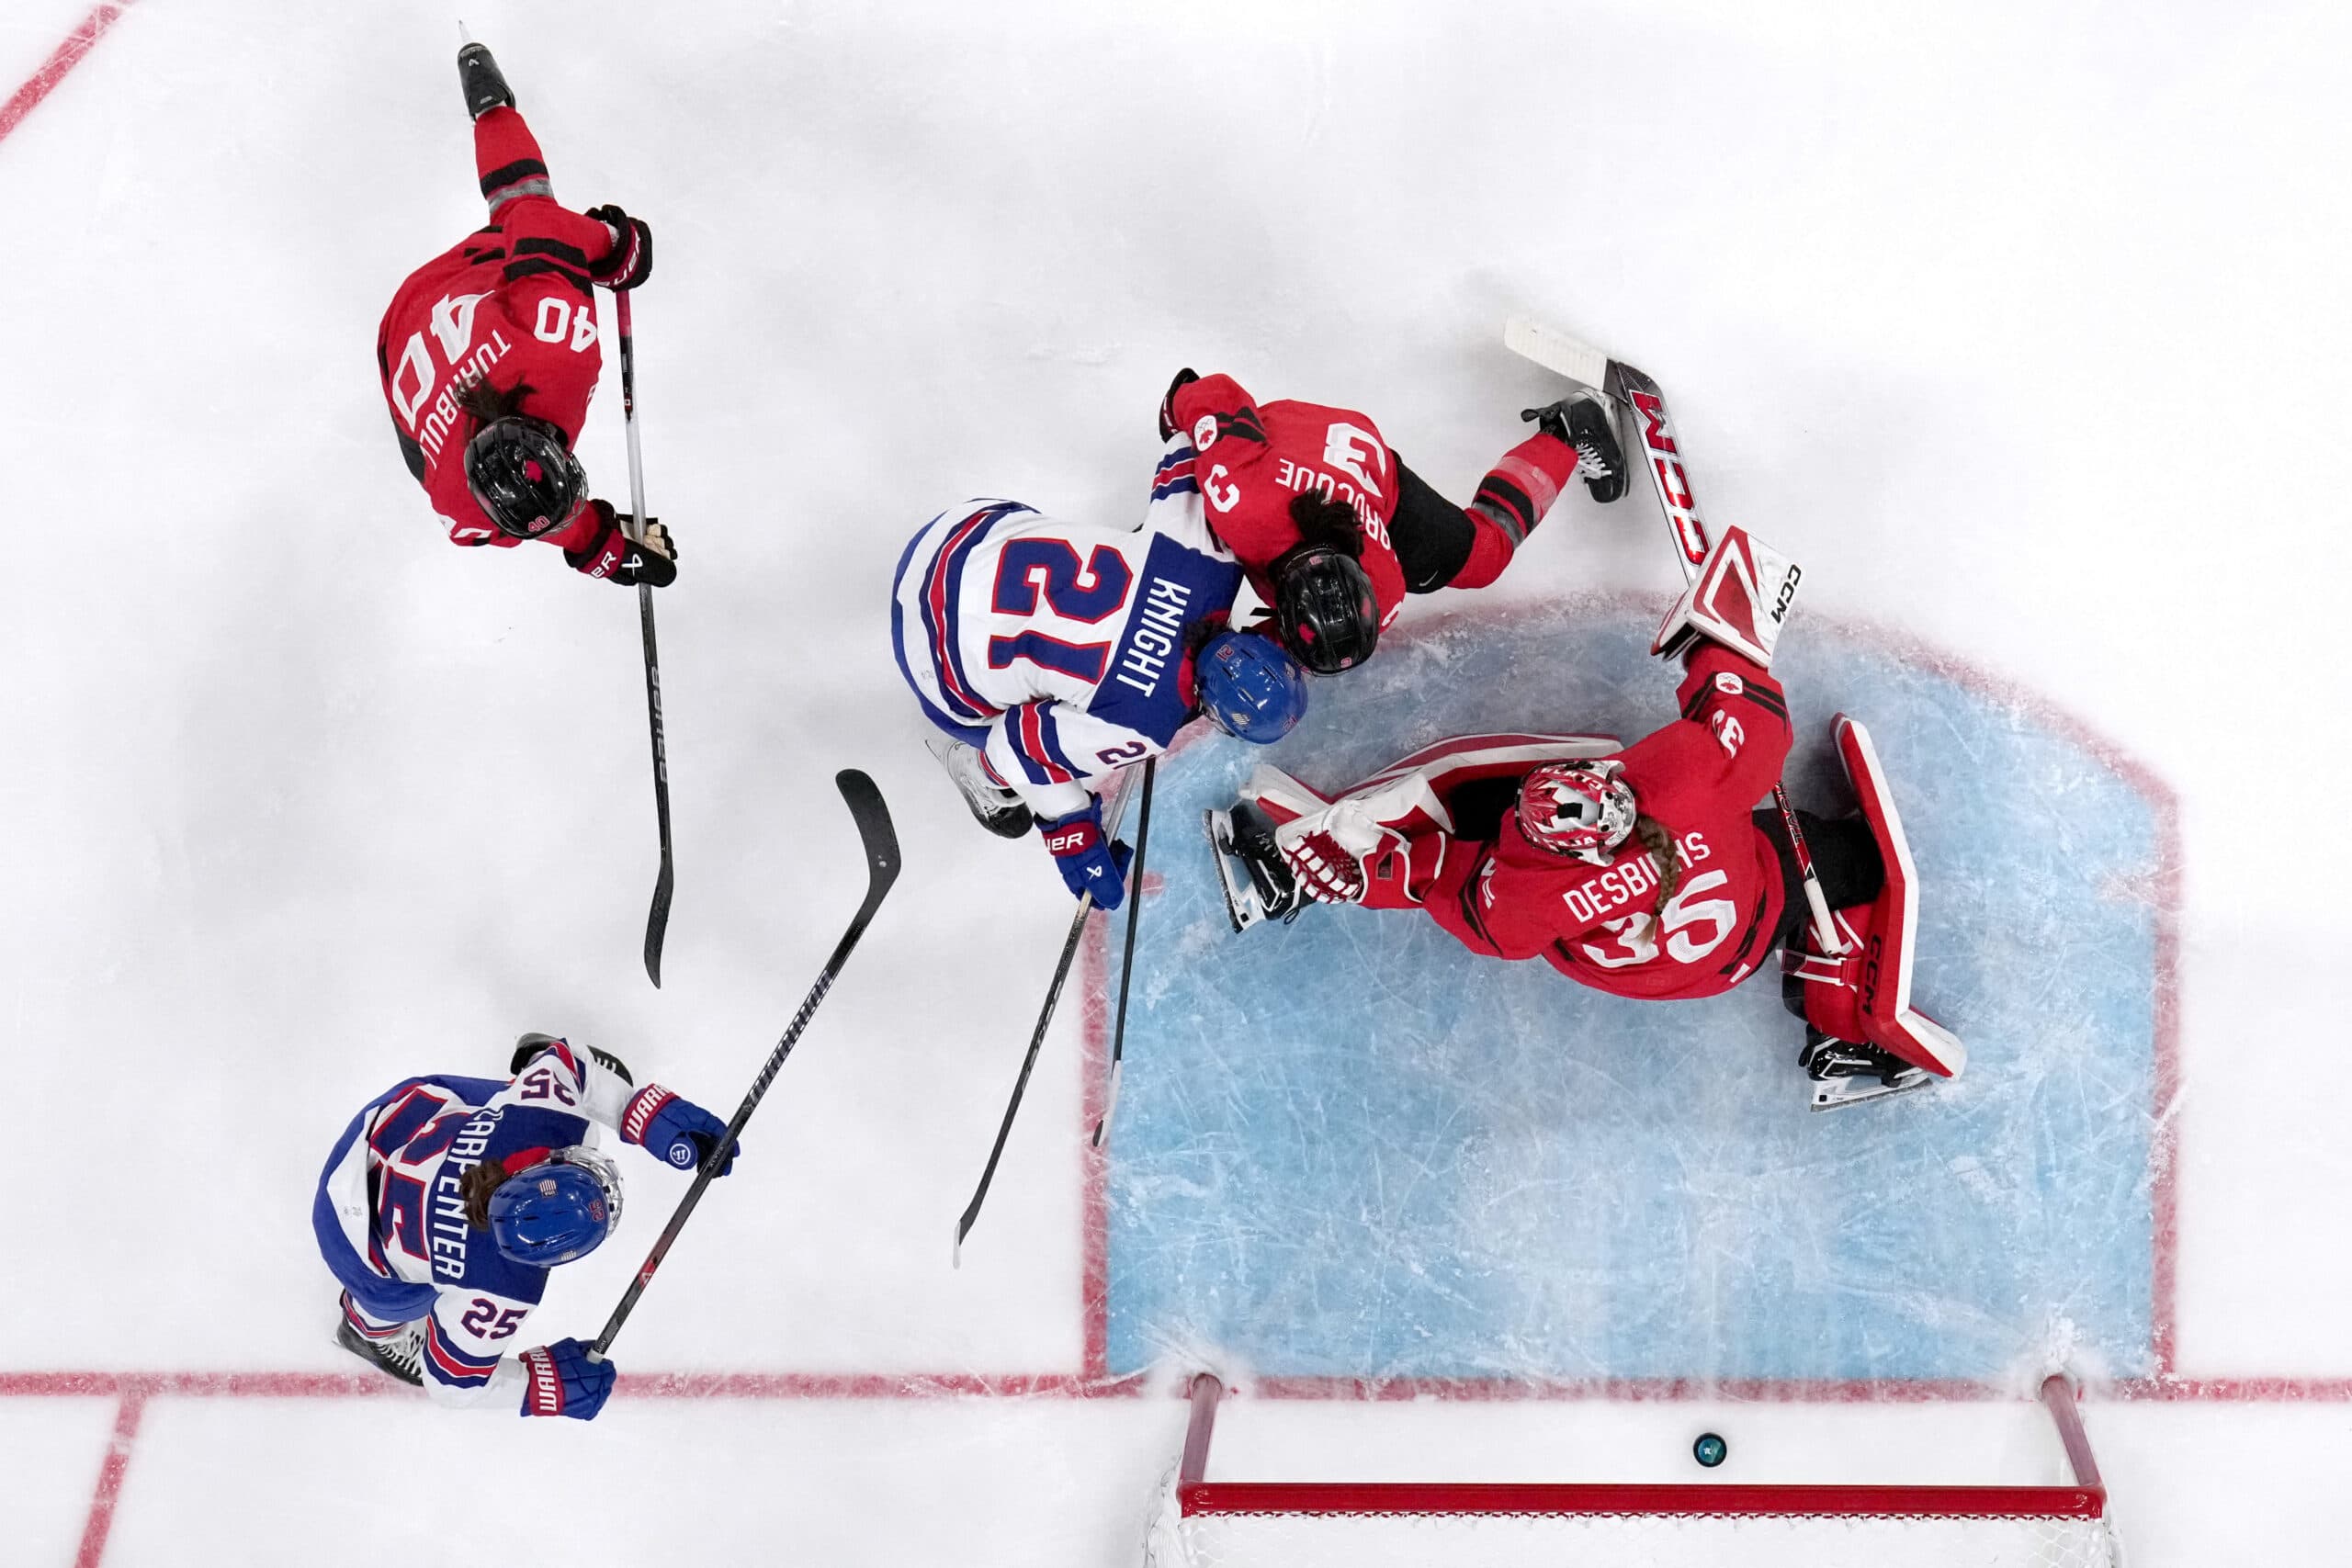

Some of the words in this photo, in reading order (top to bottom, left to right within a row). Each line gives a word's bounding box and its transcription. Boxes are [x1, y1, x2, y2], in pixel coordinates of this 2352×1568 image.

[393, 289, 494, 432] 40
[535, 297, 598, 354] 40
[1203, 463, 1241, 513] 3
[1323, 422, 1387, 498] 3
[1632, 390, 1710, 566] CCM
[527, 515, 550, 533] 40
[989, 536, 1134, 686] 21
[1770, 563, 1802, 625] CCM
[1116, 577, 1192, 699] KNIGHT
[1216, 645, 1235, 662] 21
[1562, 831, 1711, 924] DESBIS
[1582, 868, 1737, 969] 35
[1861, 934, 1883, 1017] CCM
[433, 1108, 504, 1280] CARPENTER
[460, 1297, 529, 1340] 25
